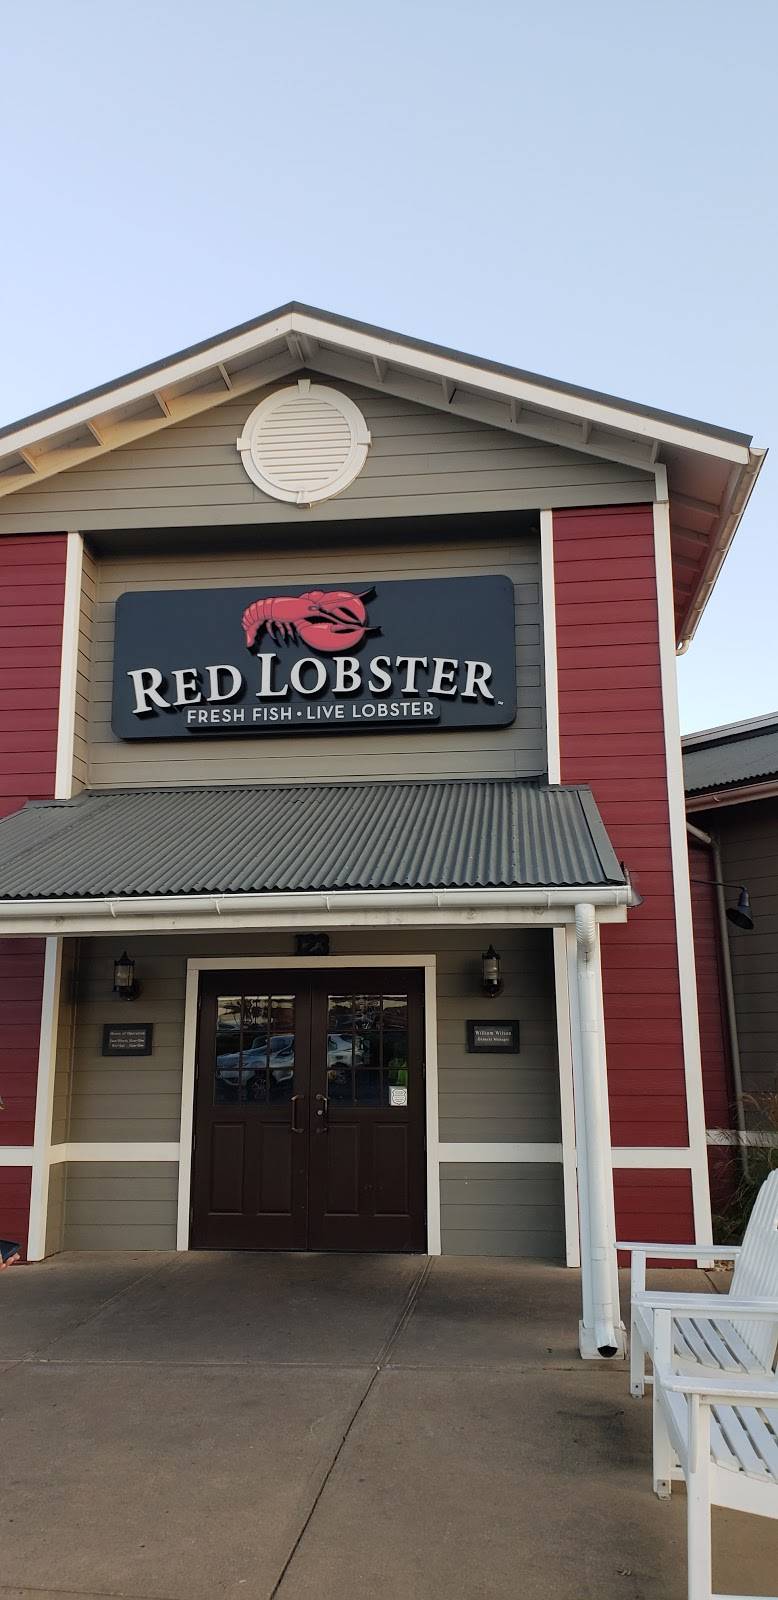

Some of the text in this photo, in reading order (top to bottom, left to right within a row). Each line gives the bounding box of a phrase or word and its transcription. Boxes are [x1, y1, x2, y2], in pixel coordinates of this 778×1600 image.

[127, 653, 494, 714] RED LOBSTER
[187, 702, 434, 723] FRESH FISH LIVE LOBSTER
